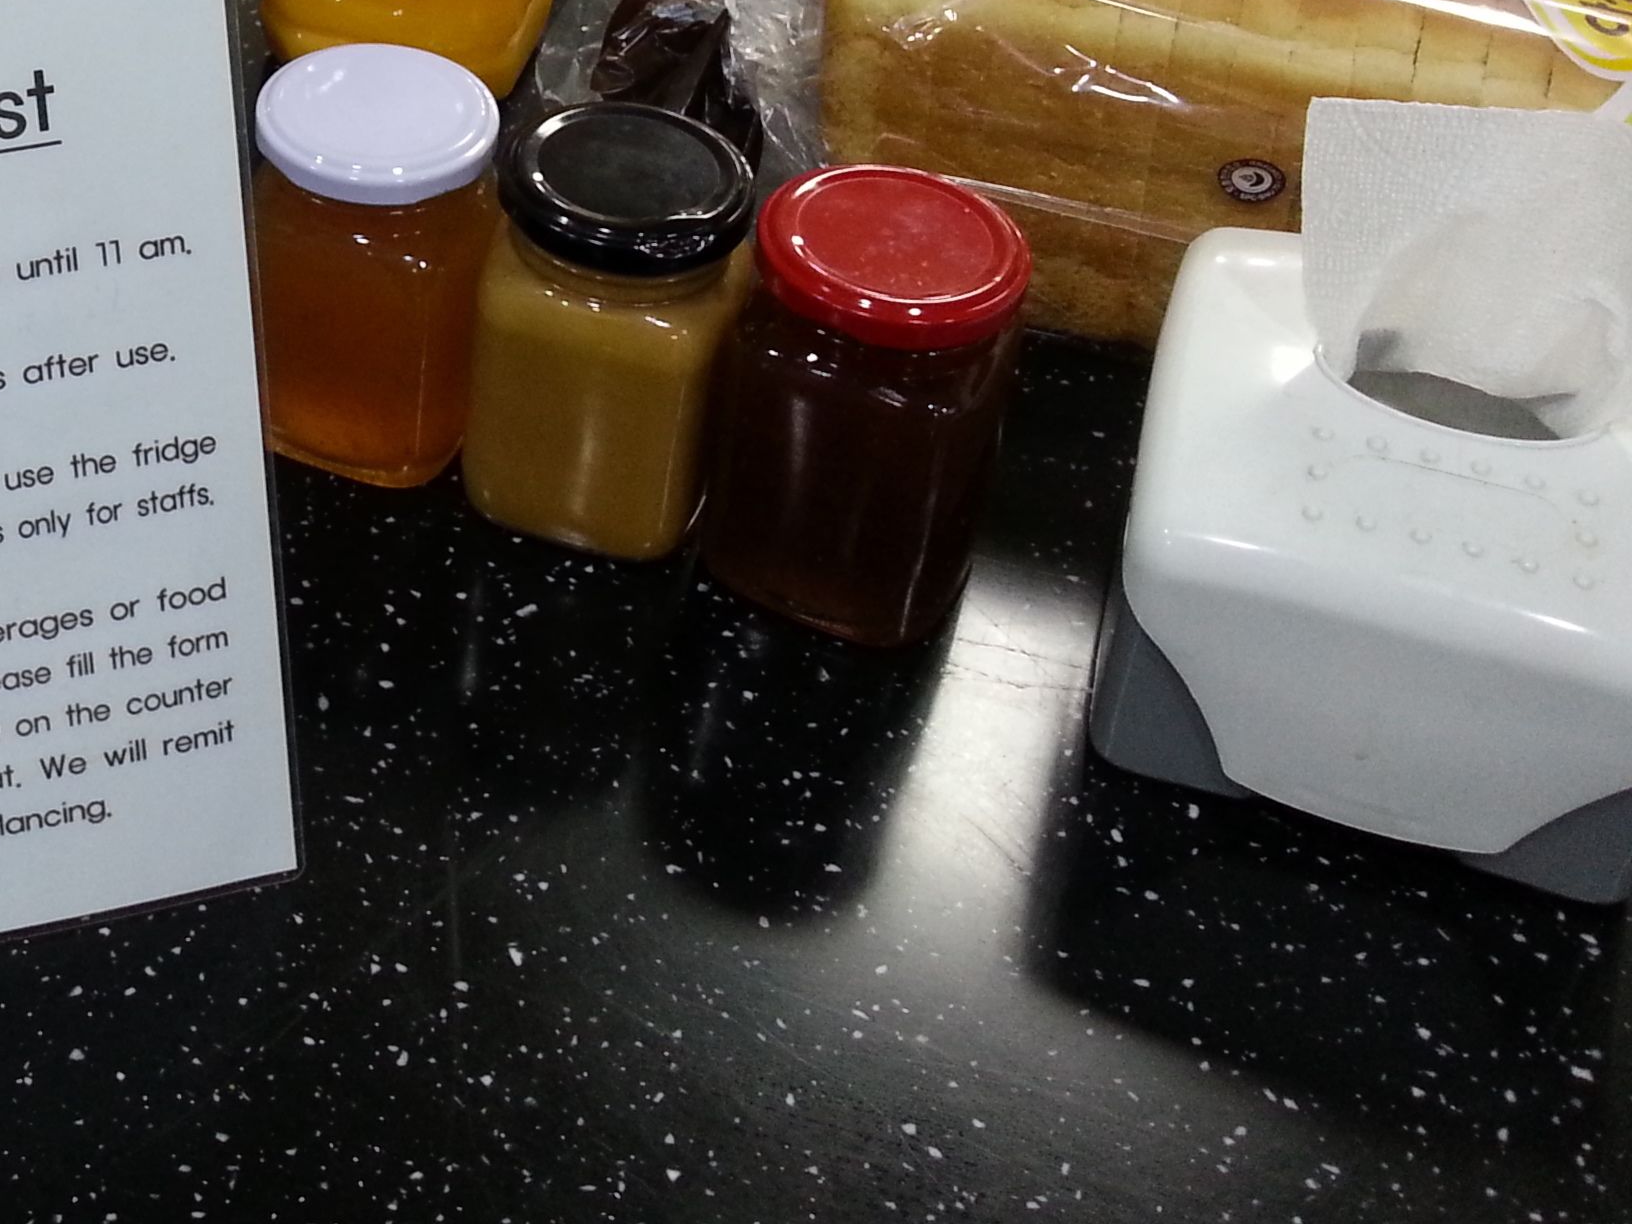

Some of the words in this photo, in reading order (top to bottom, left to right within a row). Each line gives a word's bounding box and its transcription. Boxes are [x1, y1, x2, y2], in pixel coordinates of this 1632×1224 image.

[16, 246, 78, 281] until
[95, 239, 122, 267] 11
[138, 235, 192, 260] am.
[22, 353, 99, 385] after
[116, 342, 176, 369] use.
[4, 465, 55, 491] use
[70, 453, 117, 479] the
[131, 435, 217, 467] fridge
[18, 509, 71, 539] only
[86, 501, 123, 526] for
[137, 482, 215, 518] staffs.
[109, 599, 141, 622] or
[156, 575, 227, 613] food
[65, 651, 95, 678] fill
[109, 645, 153, 670] the
[167, 631, 229, 659] form
[15, 715, 51, 737] on
[65, 702, 111, 727] the
[125, 677, 233, 716] counter
[39, 753, 87, 780] We
[103, 738, 148, 768] will
[162, 719, 235, 756] remit
